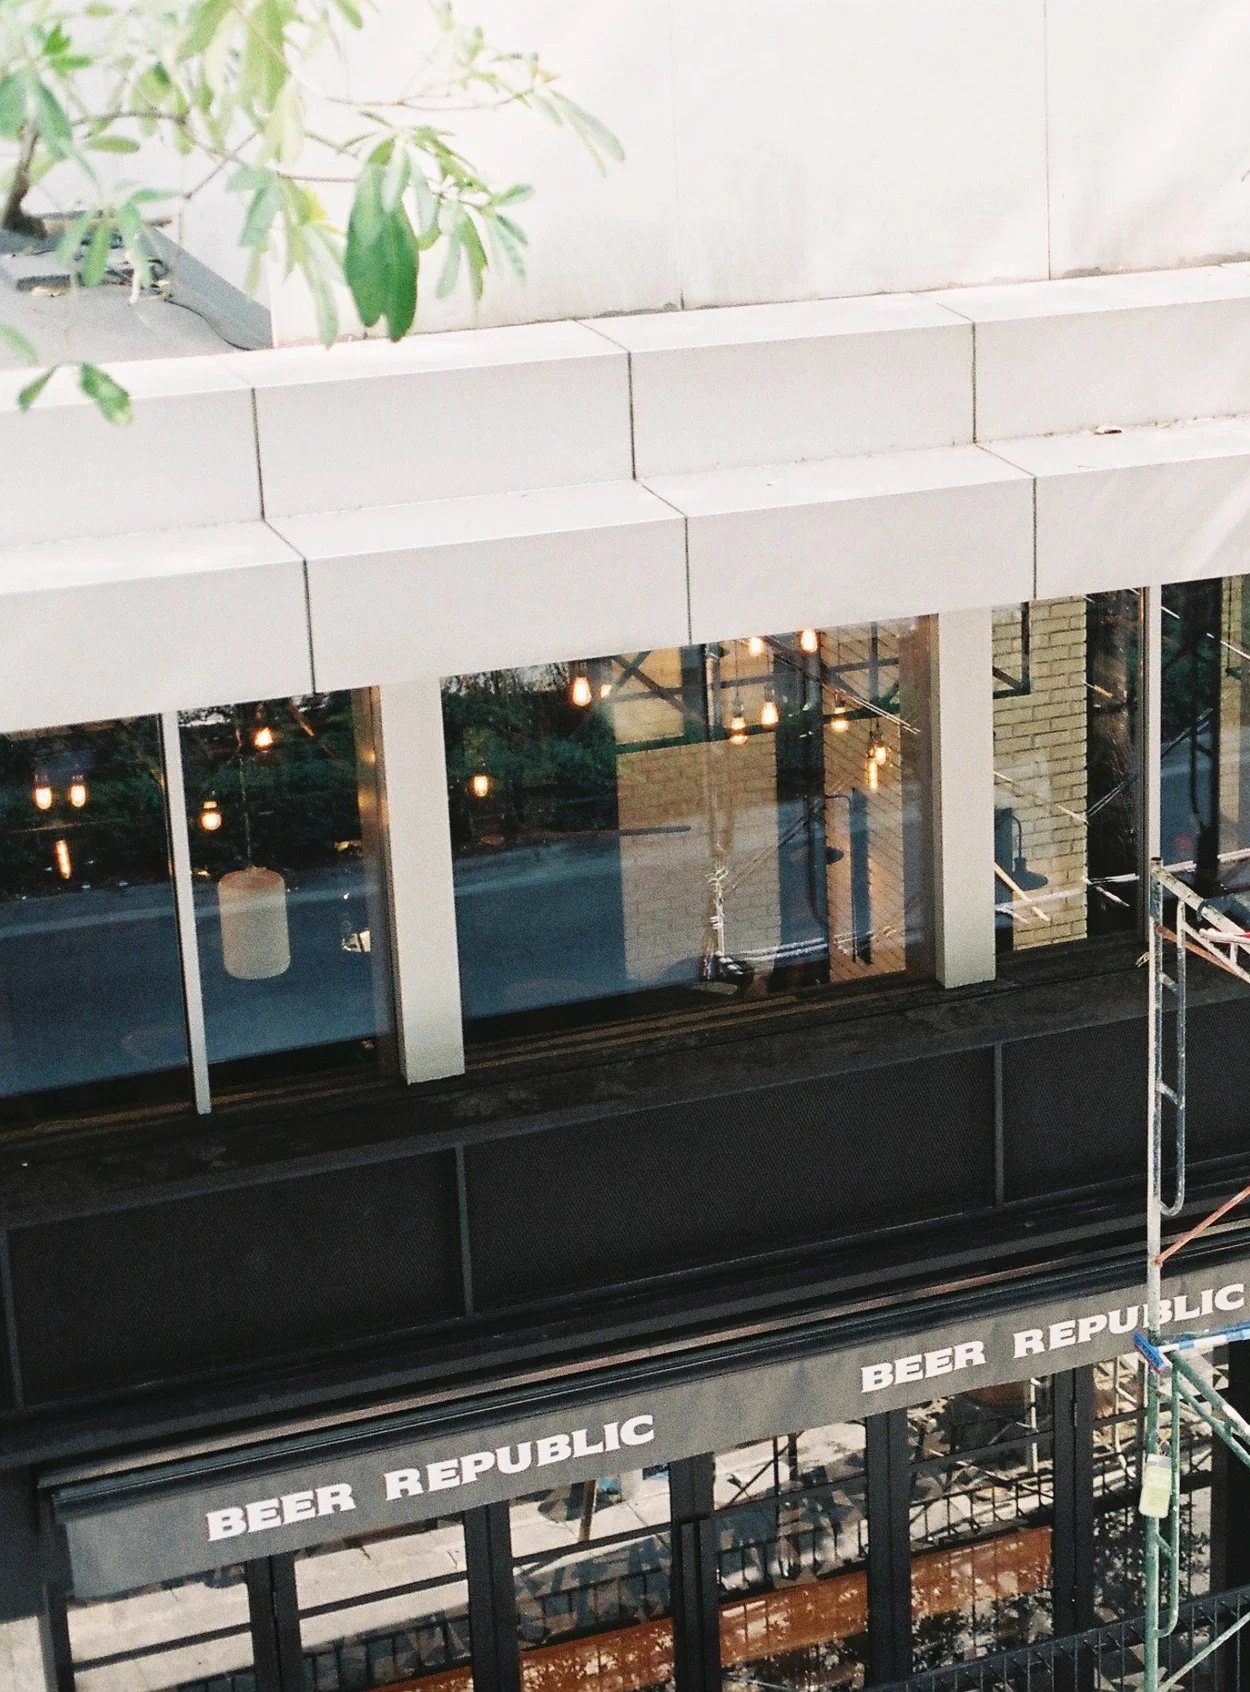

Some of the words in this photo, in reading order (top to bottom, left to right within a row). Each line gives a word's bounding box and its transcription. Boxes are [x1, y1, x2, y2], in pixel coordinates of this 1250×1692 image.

[861, 1341, 986, 1393] BEER
[1013, 1283, 1245, 1358] REPUBLIC
[206, 1483, 356, 1541] BEER
[384, 1414, 655, 1501] REPUBLIC
